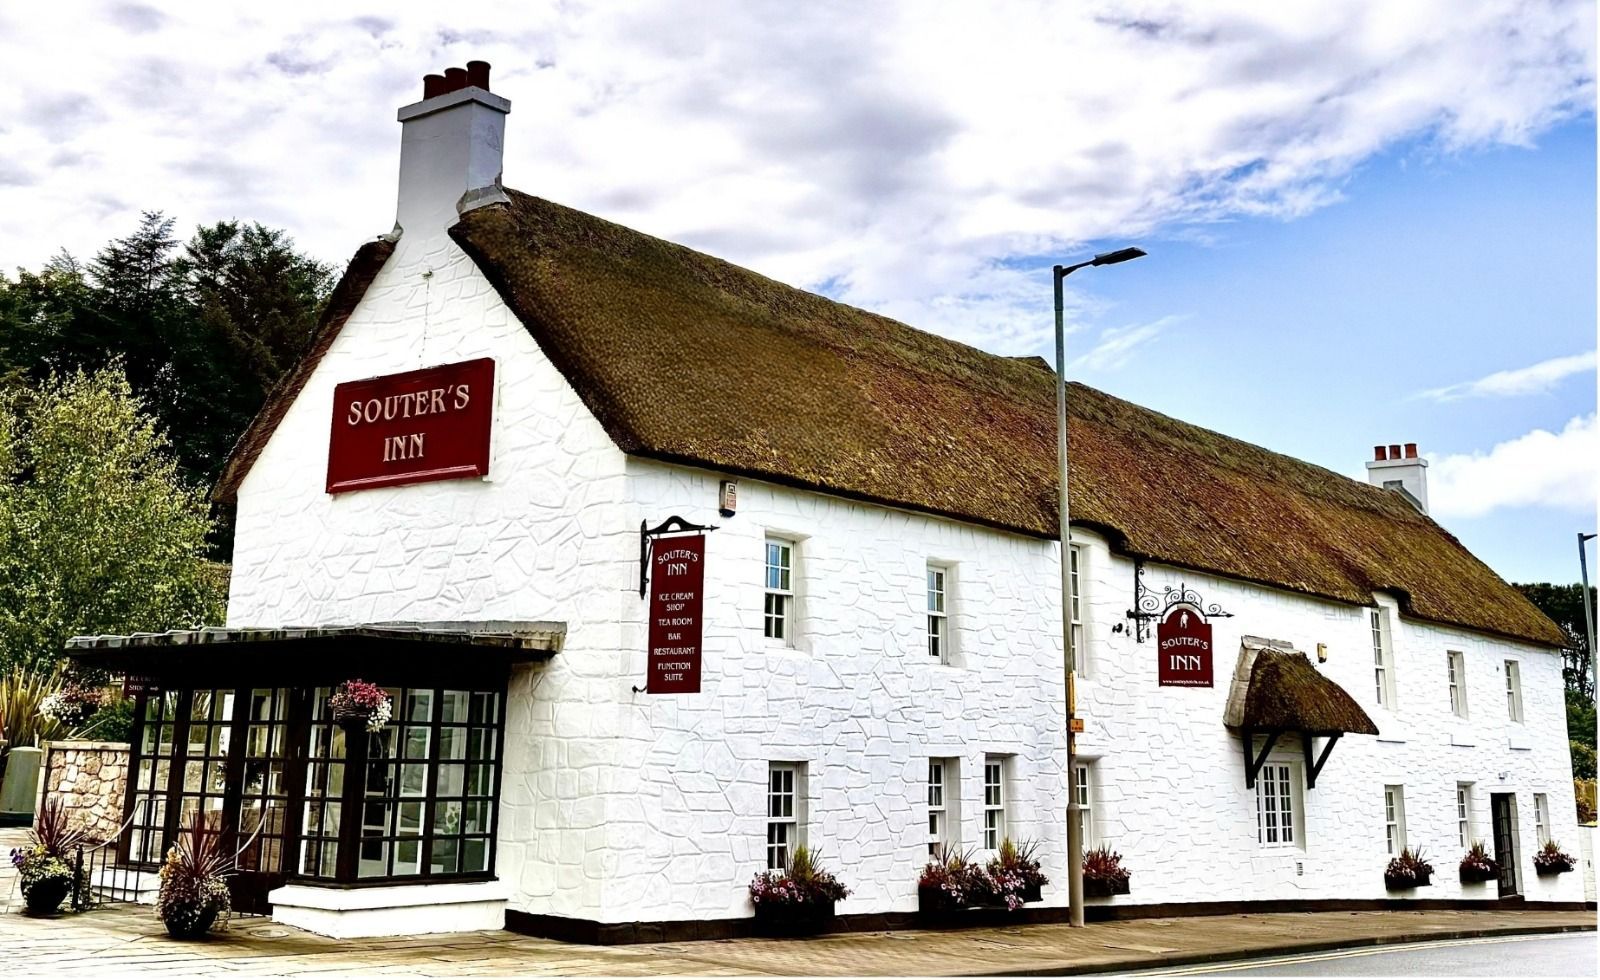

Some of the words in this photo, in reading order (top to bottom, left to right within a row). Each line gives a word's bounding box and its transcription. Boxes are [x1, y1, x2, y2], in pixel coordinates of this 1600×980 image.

[347, 384, 470, 426] SOUTER'S
[382, 432, 426, 463] INN
[657, 549, 699, 565] SOUTER'S
[667, 563, 688, 577] INN
[658, 593, 670, 602] ICE
[670, 592, 694, 601] CREAM
[666, 603, 685, 612] SHOP
[658, 618, 671, 627] TEA
[671, 617, 693, 626] ROOM
[667, 632, 682, 641] BAR
[1161, 636, 1209, 650] SOUTER'S
[653, 647, 696, 656] RESTAURANT
[657, 662, 691, 670] FUNCTION
[1170, 654, 1201, 671] INN
[664, 673, 684, 681] SUITE
